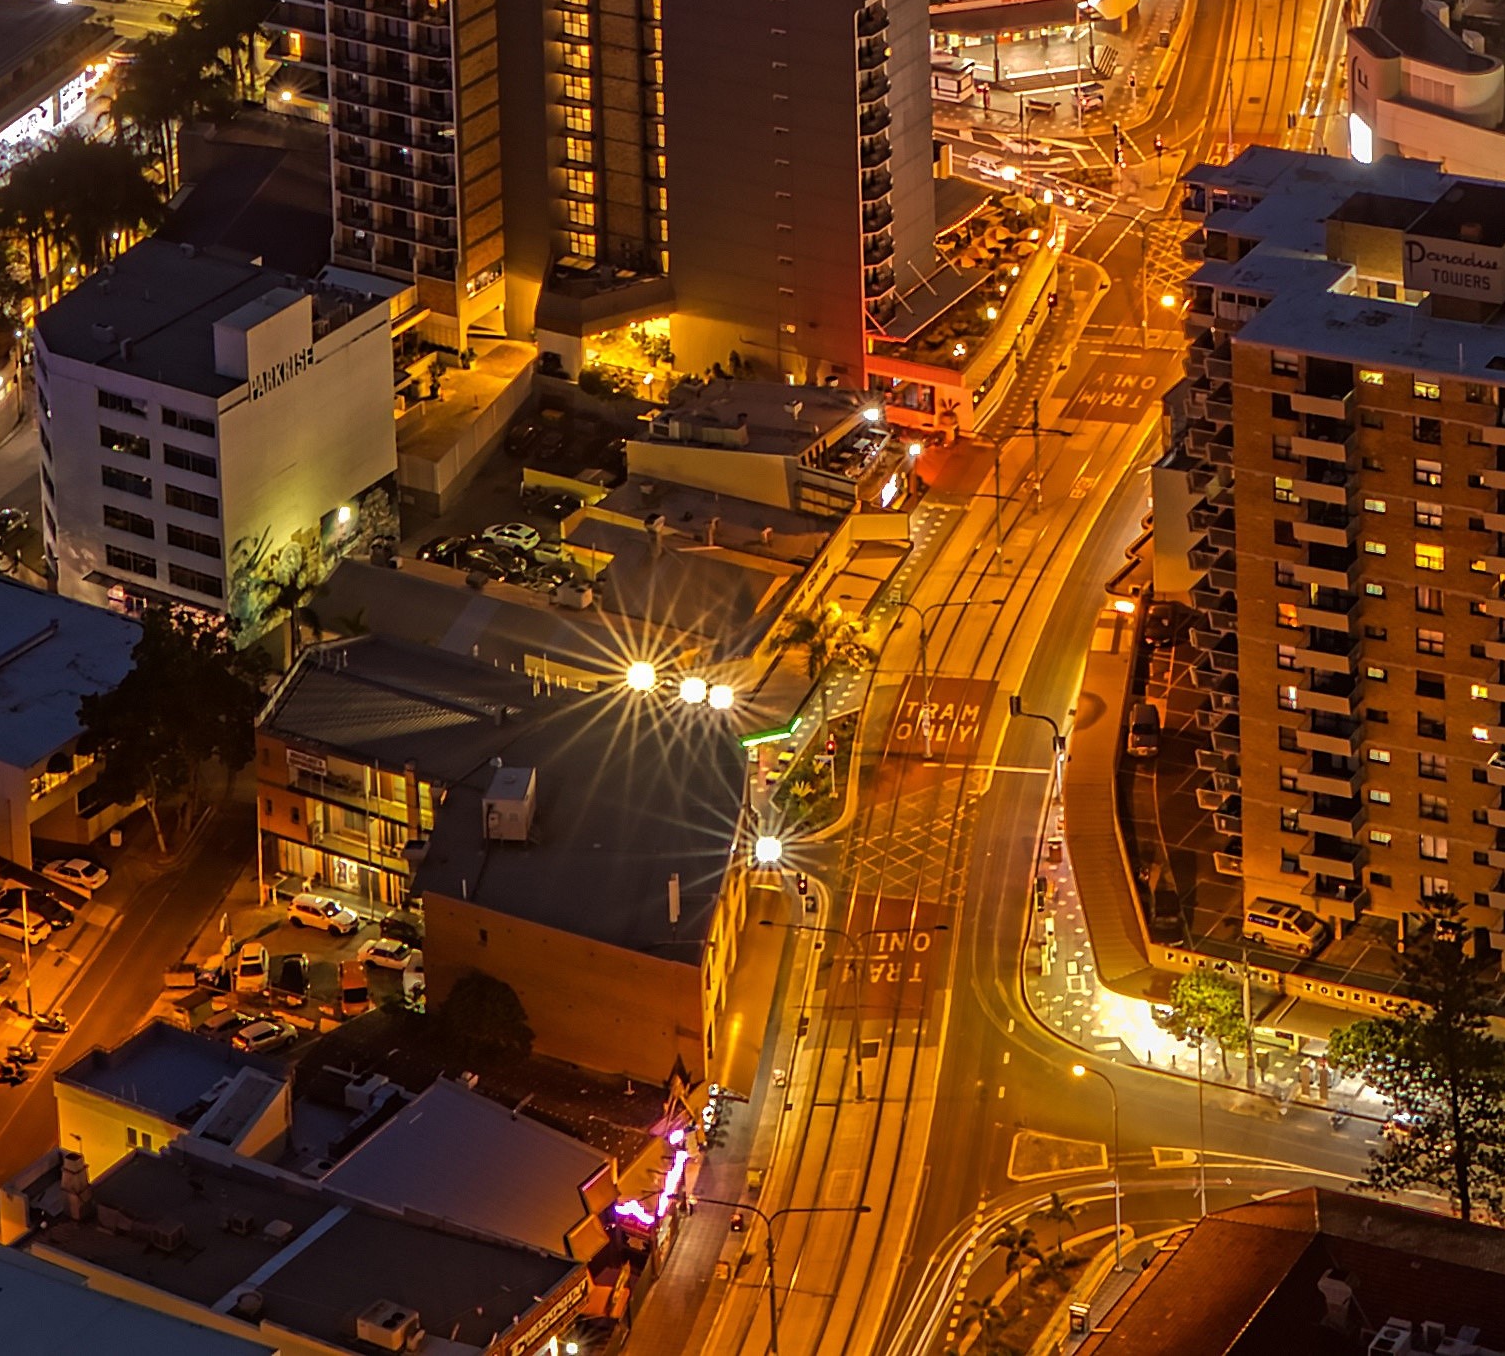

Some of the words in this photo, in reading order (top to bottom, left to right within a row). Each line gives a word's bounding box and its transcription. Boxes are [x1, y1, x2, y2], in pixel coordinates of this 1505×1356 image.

[1405, 241, 1500, 272] Paradise
[1431, 269, 1491, 291] TOWERS
[249, 348, 313, 402] PARKRISE
[1078, 390, 1142, 408] TRAM
[905, 701, 980, 722] TRAM
